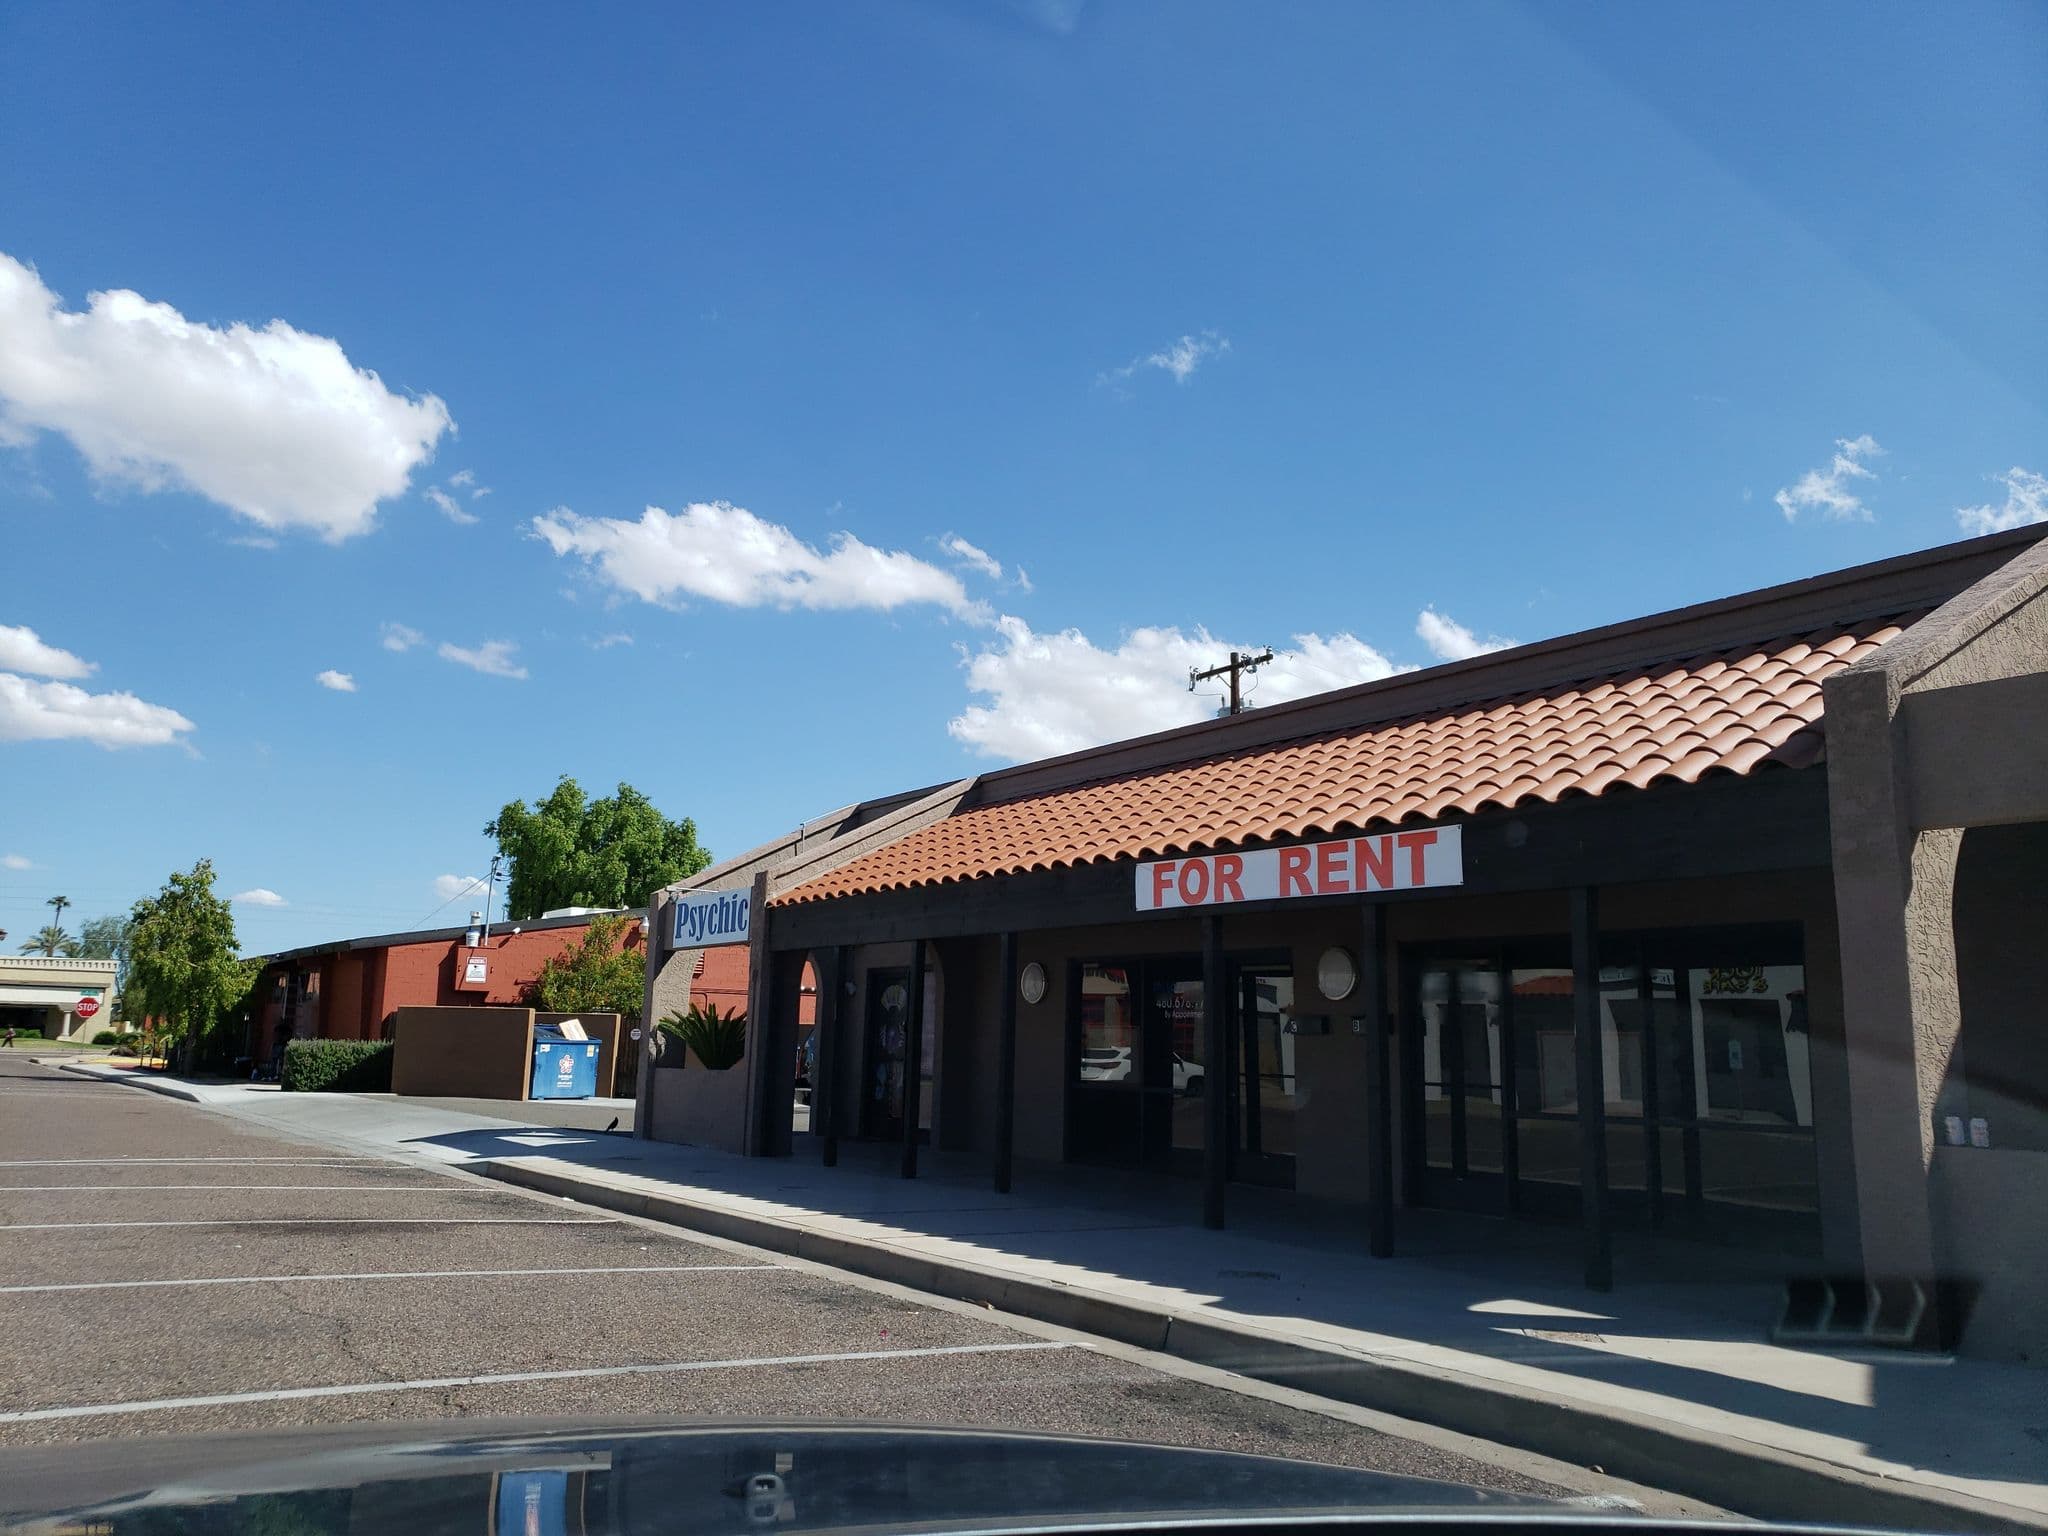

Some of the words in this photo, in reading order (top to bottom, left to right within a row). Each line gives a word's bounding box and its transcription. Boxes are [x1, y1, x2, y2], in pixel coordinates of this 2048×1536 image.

[1153, 855, 1245, 908] FOR
[1279, 831, 1438, 897] RENT
[675, 893, 749, 942] Psychic
[77, 1003, 98, 1011] STOP
